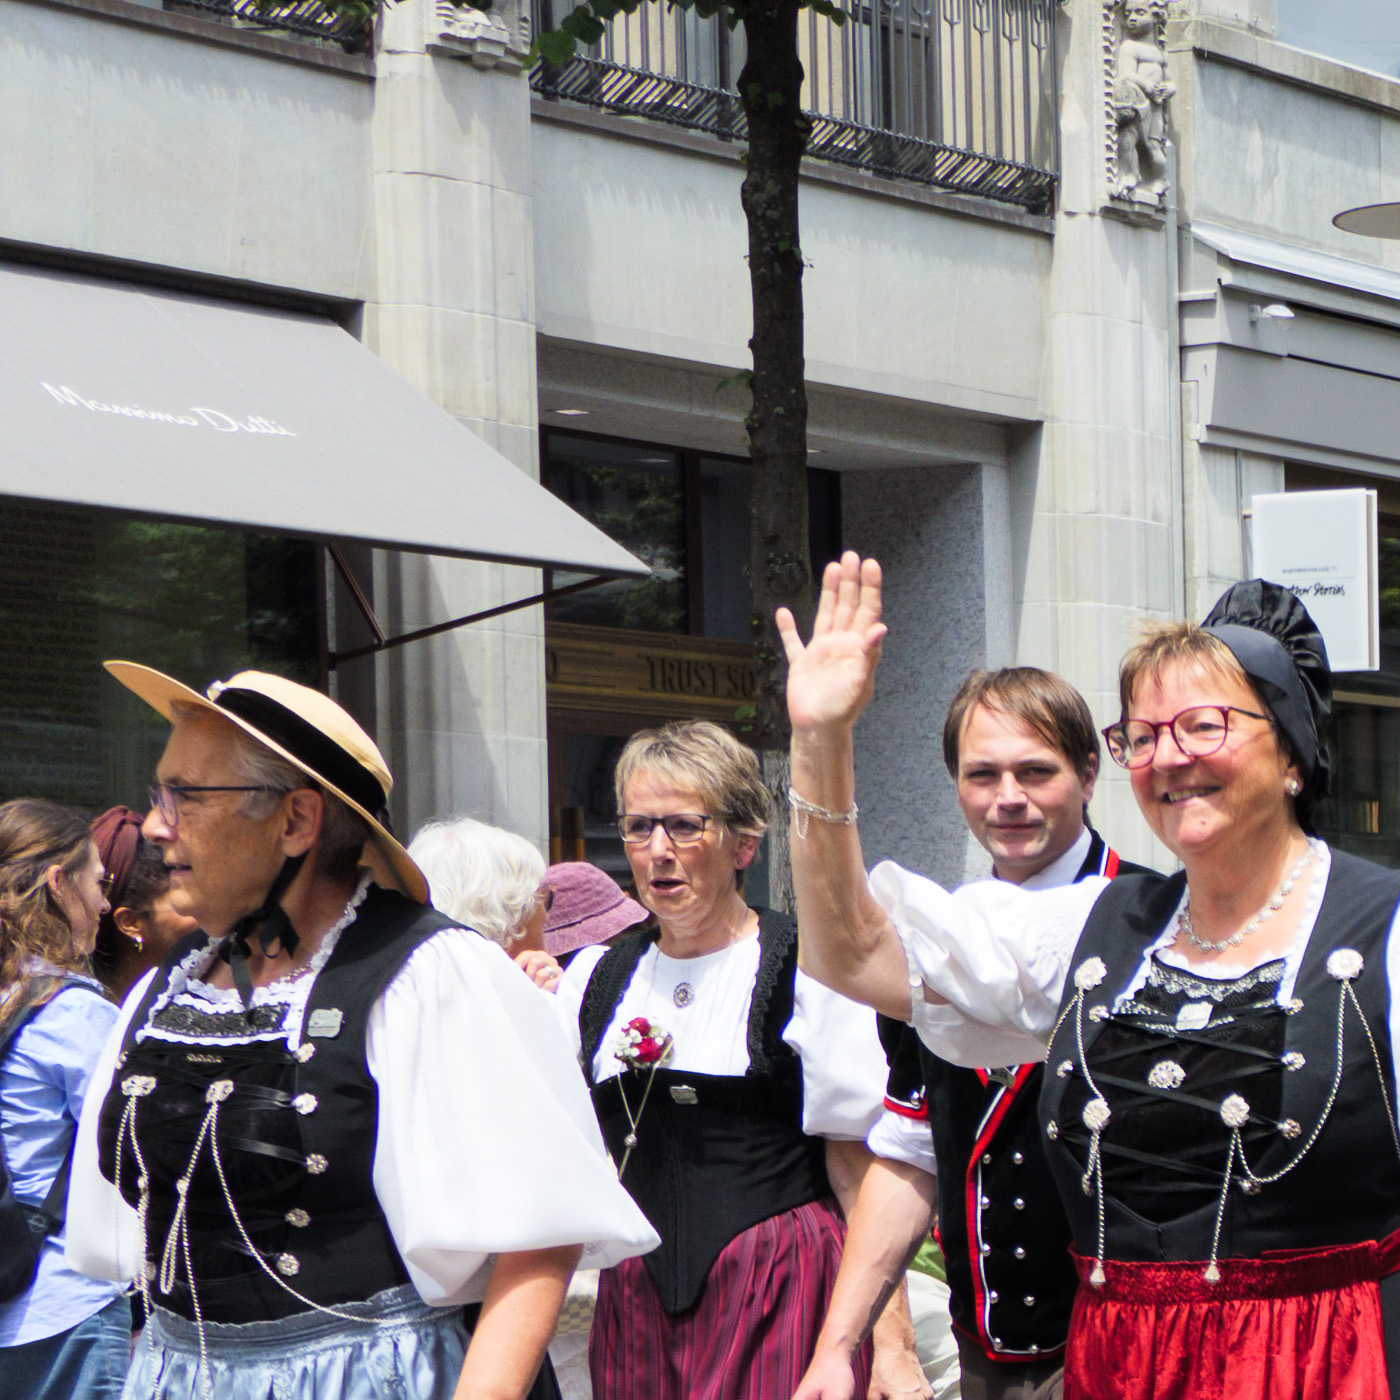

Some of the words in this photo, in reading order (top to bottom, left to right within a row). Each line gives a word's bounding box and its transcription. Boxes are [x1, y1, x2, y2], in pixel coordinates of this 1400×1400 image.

[40, 380, 200, 427] Massimo
[190, 407, 297, 437] Dutti
[1288, 584, 1312, 596] ther
[1313, 582, 1345, 596] Stories
[646, 656, 717, 695] TRUST
[726, 663, 756, 698] SO
